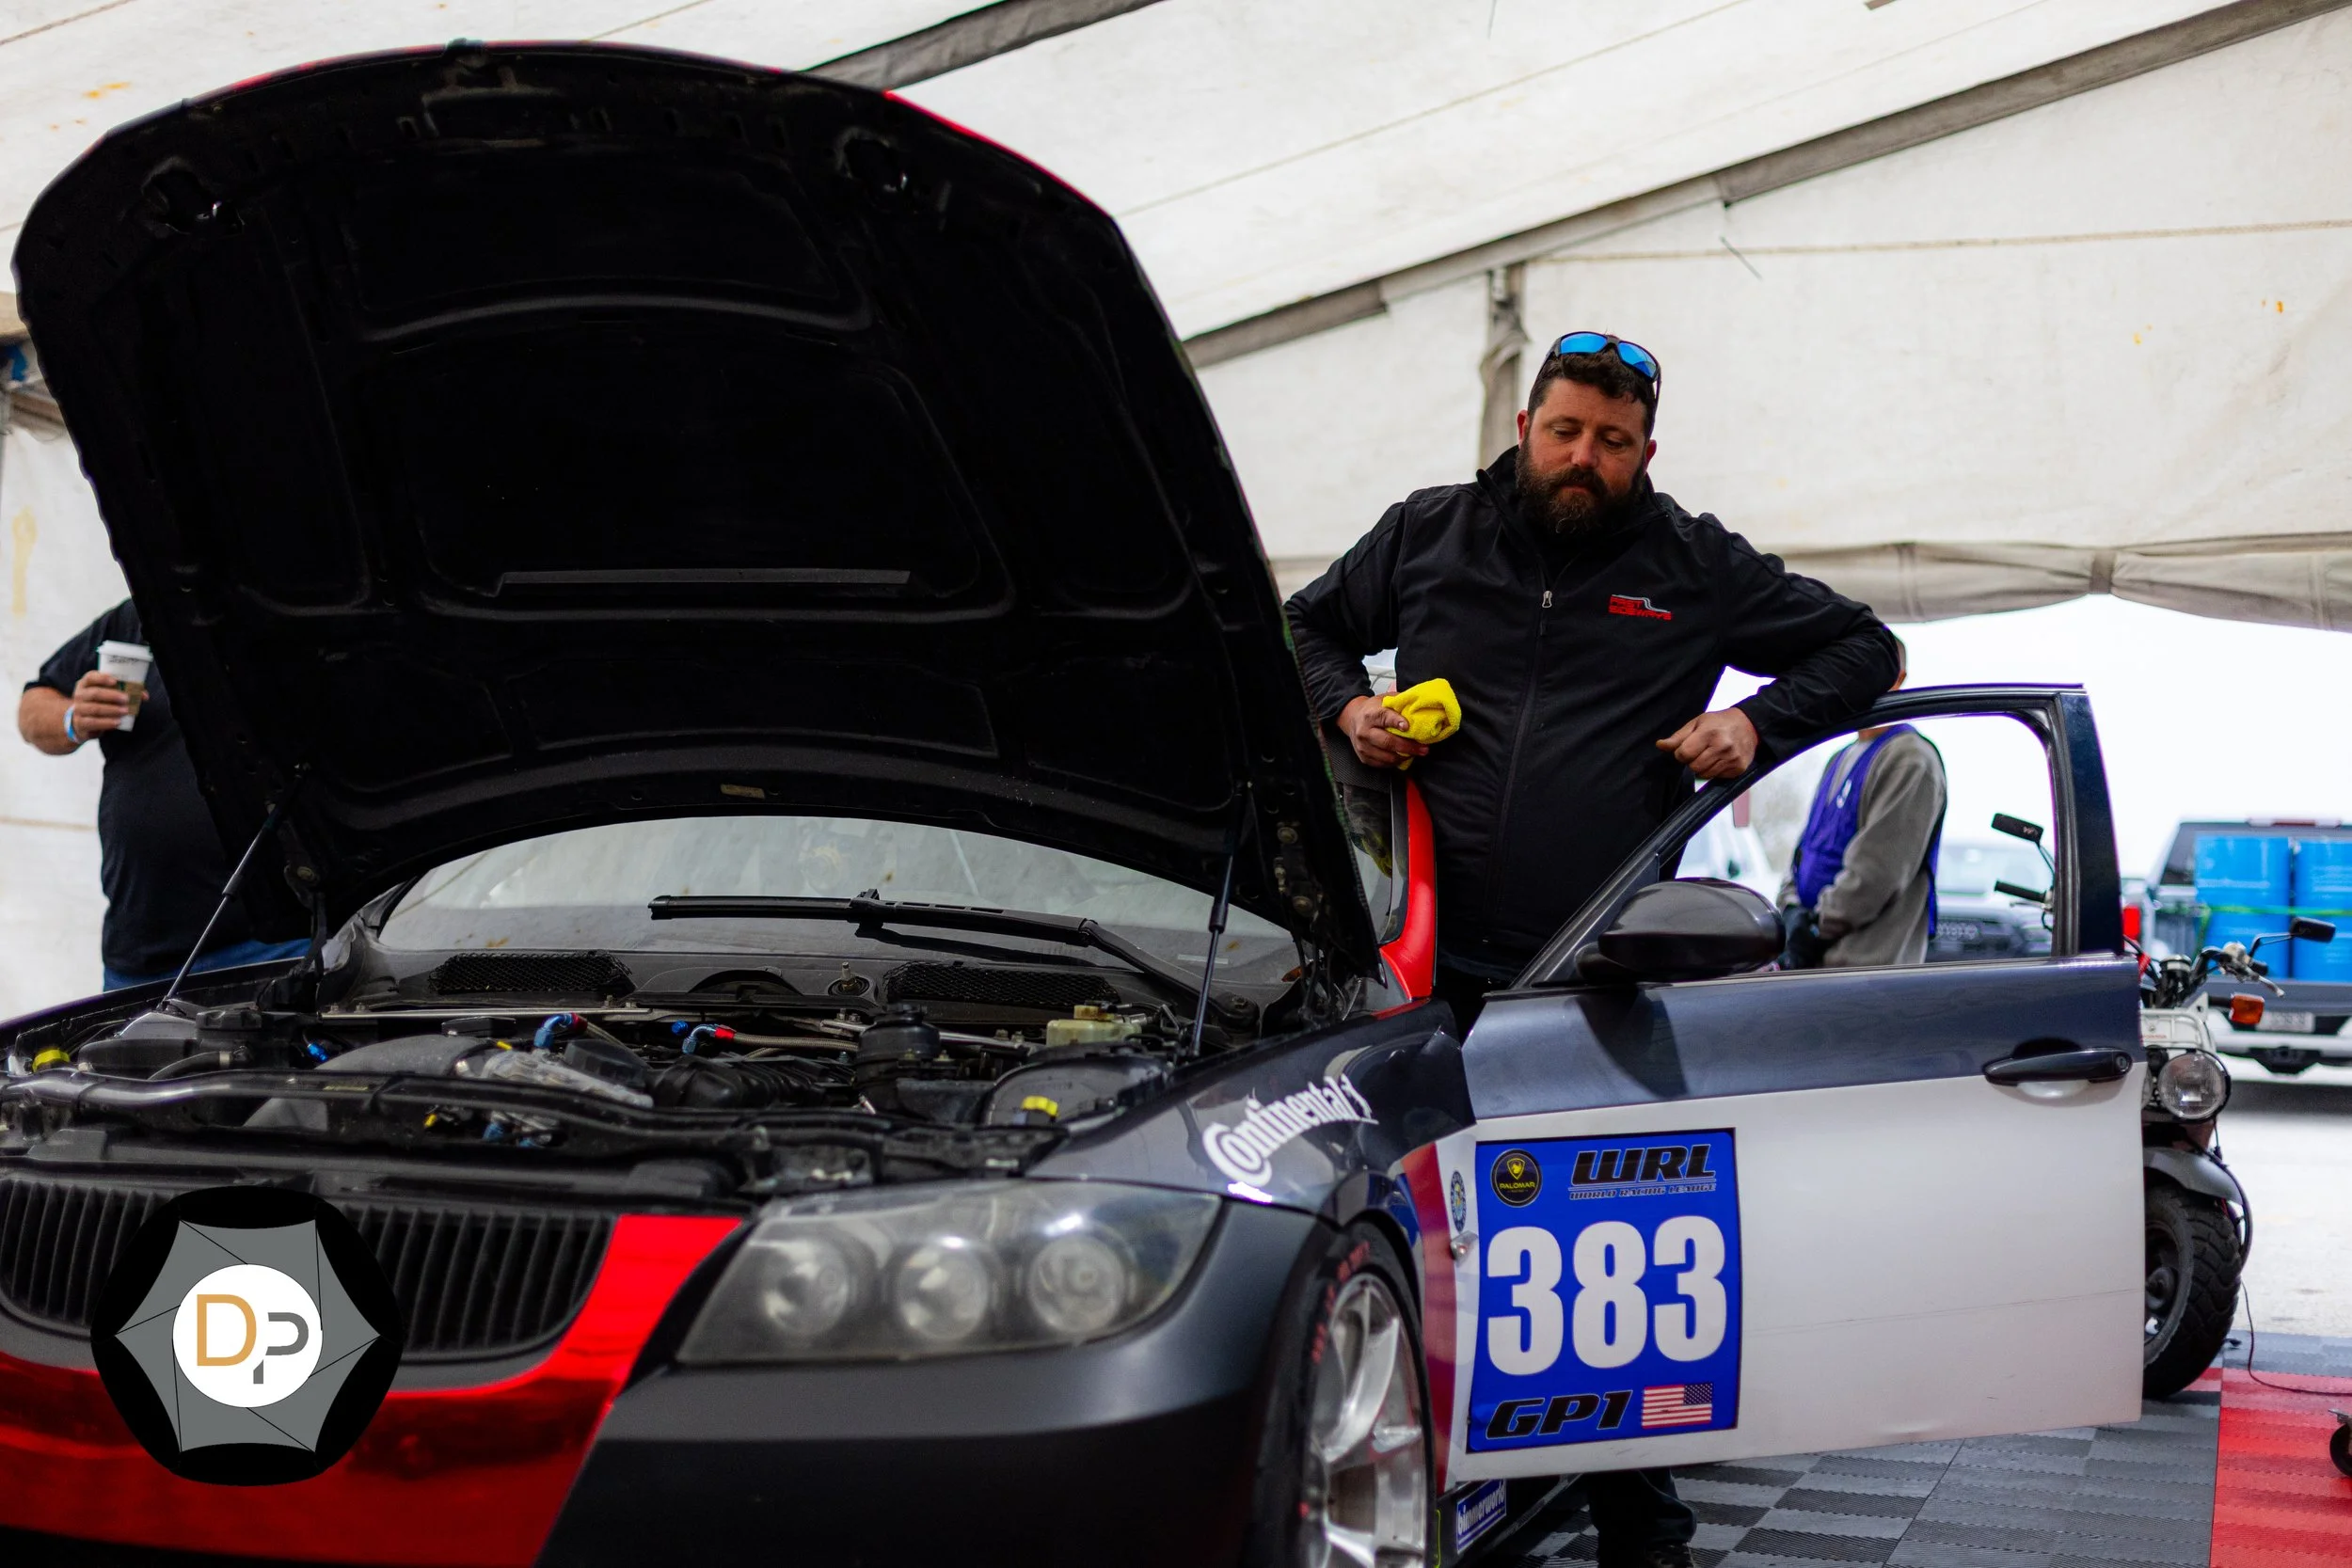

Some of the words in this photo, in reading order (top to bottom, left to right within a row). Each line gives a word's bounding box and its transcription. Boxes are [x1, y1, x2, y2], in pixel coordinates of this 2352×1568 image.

[1202, 1075, 1362, 1186] Continental
[1571, 1144, 1716, 1186] WRL
[1569, 1189, 1616, 1200] WORLD
[1619, 1186, 1666, 1197] RACING
[1486, 1215, 1727, 1376] 383
[1486, 1389, 1633, 1439] GP1
